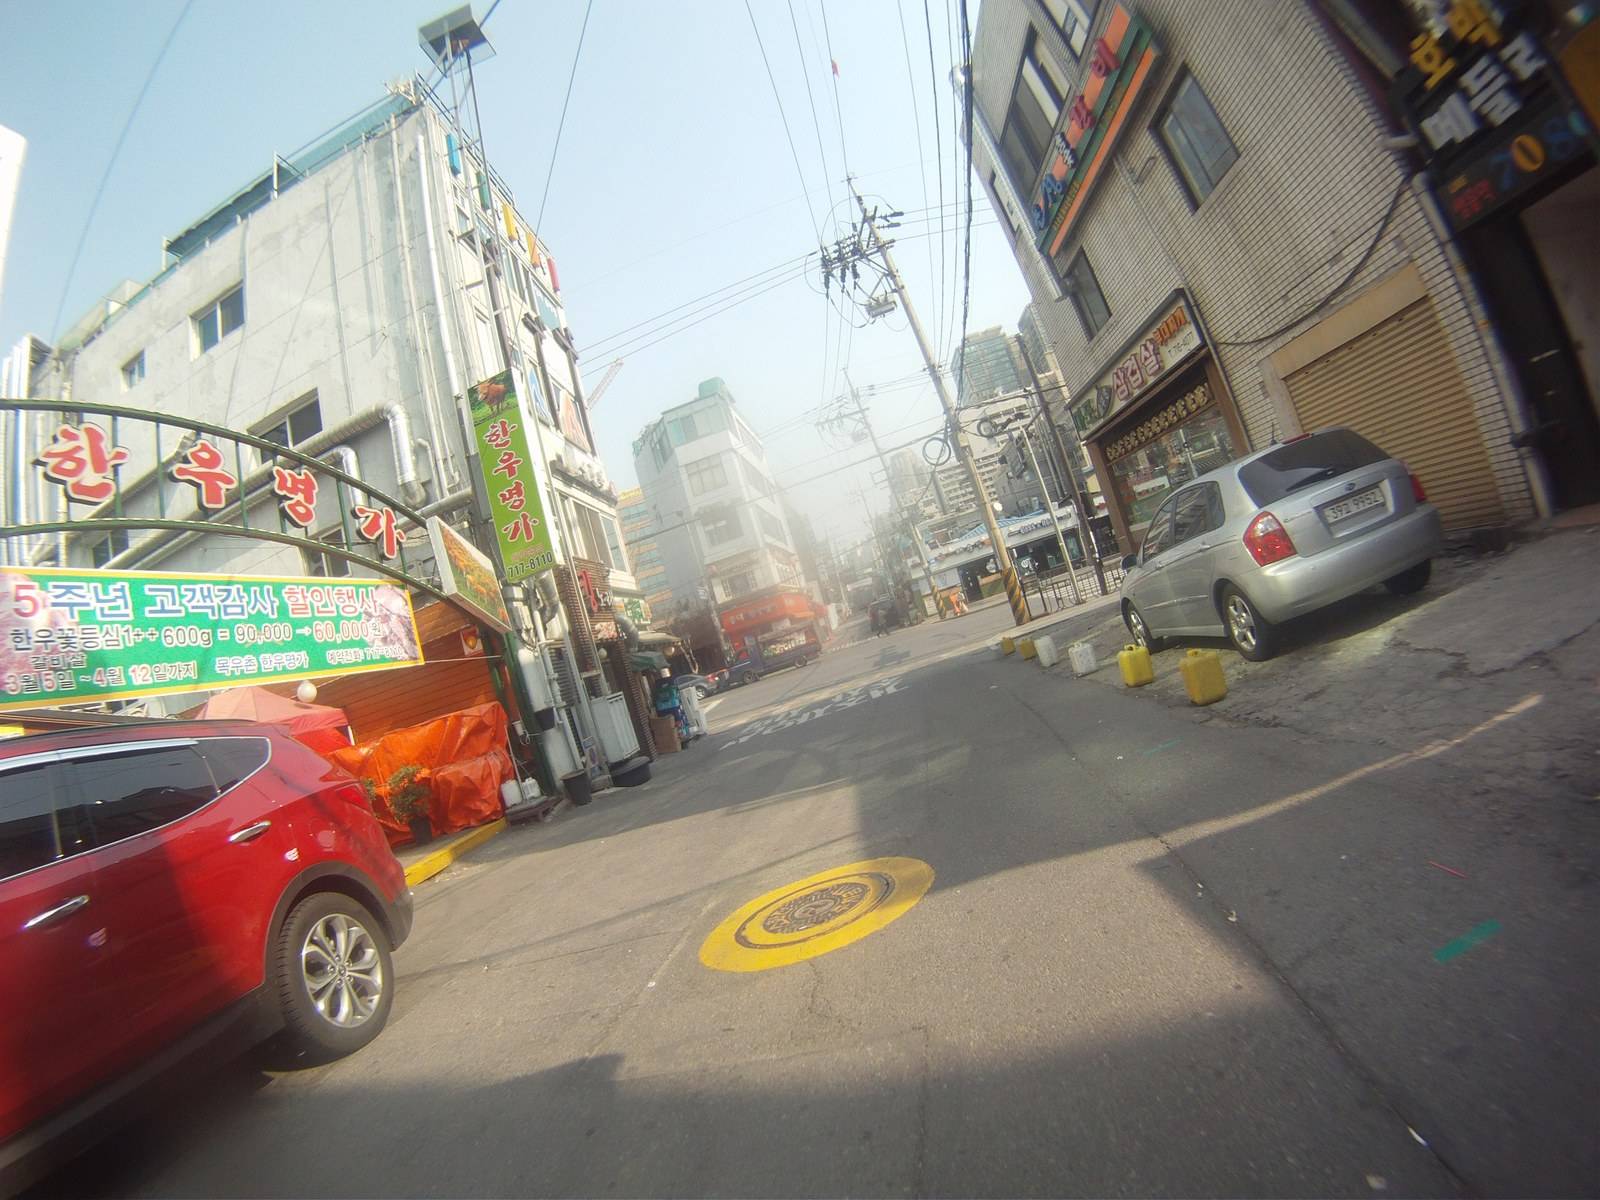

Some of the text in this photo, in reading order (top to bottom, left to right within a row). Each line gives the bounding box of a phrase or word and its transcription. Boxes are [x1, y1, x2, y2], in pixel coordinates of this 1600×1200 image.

[1112, 338, 1163, 401] 삼겹살
[33, 421, 407, 562] 한우명가
[484, 418, 540, 543] 한우명가
[508, 551, 553, 578] 717-8110
[144, 583, 278, 620] 고객감사
[283, 584, 380, 618] 할인행사
[162, 625, 213, 648] 600g
[31, 653, 87, 671] 갈비살
[216, 650, 309, 675] 목우촌 한우명가
